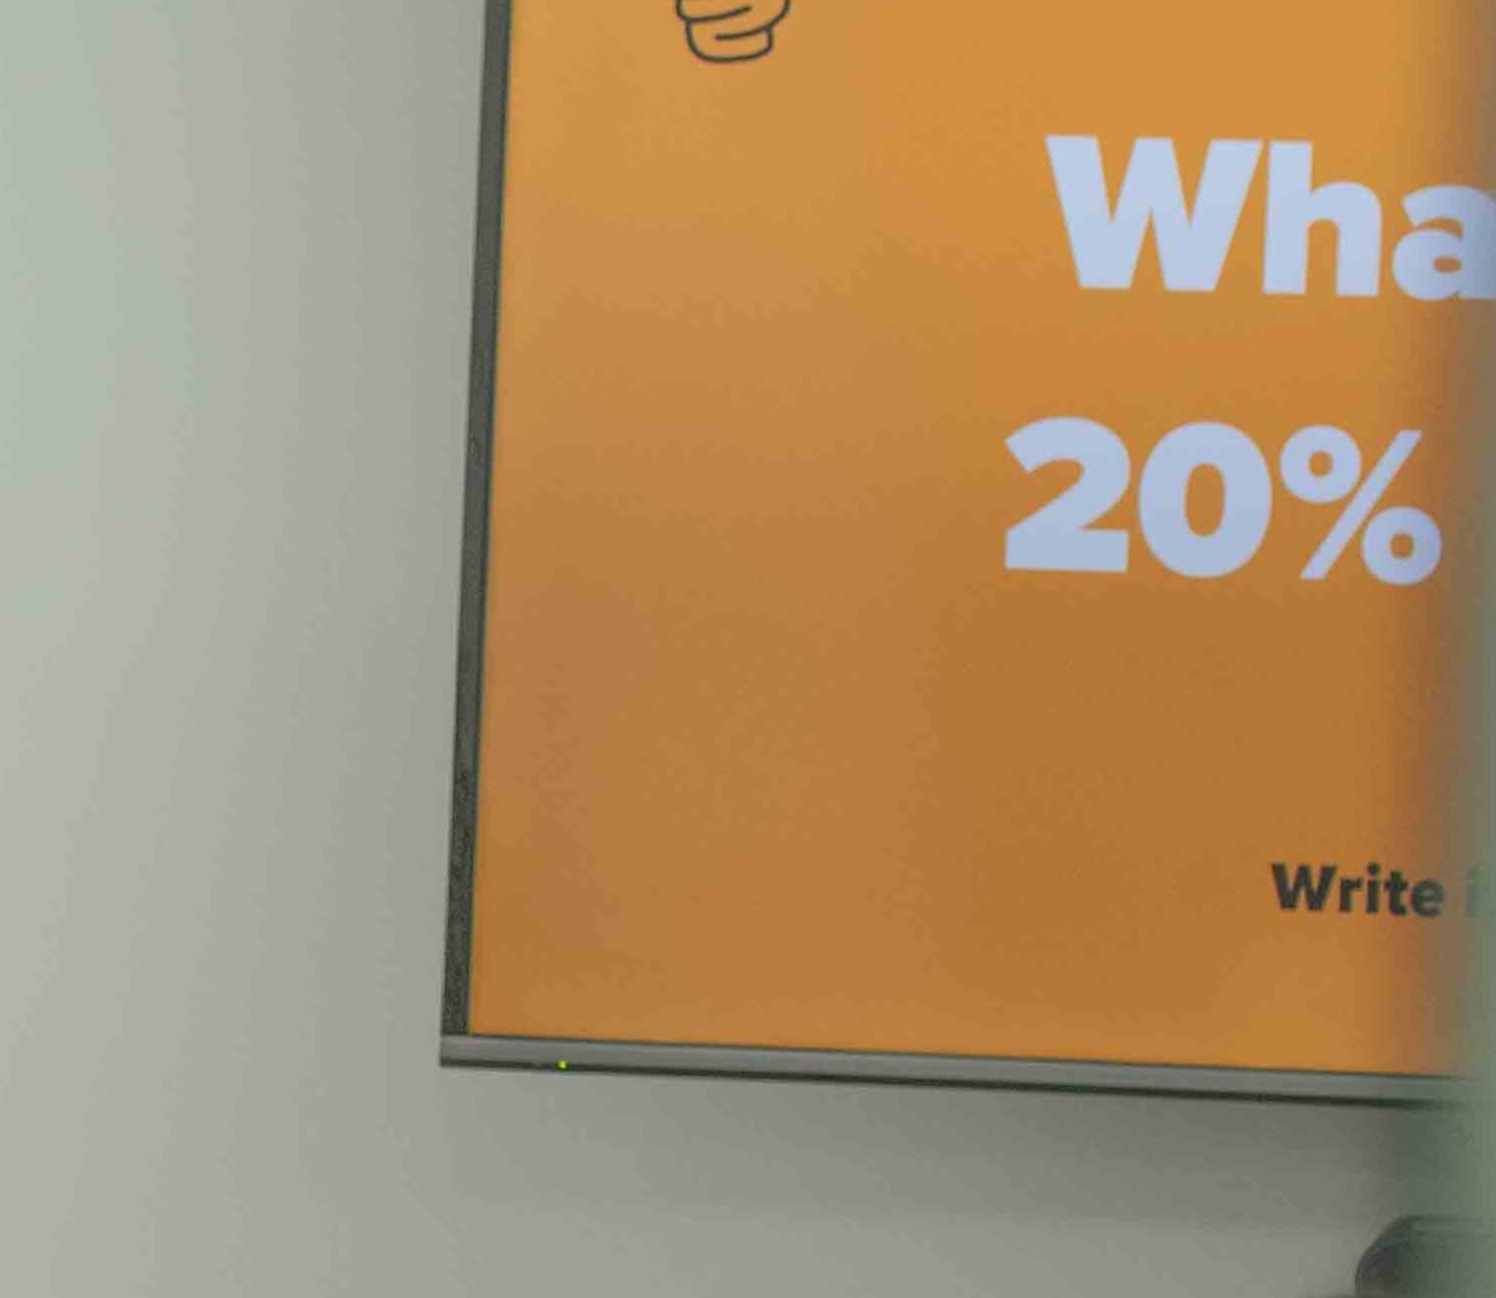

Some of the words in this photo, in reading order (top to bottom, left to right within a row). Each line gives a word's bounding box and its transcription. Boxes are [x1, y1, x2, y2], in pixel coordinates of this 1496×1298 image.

[1046, 133, 1496, 302] Wha
[1004, 415, 1443, 587] 20%
[1271, 861, 1446, 918] Write
